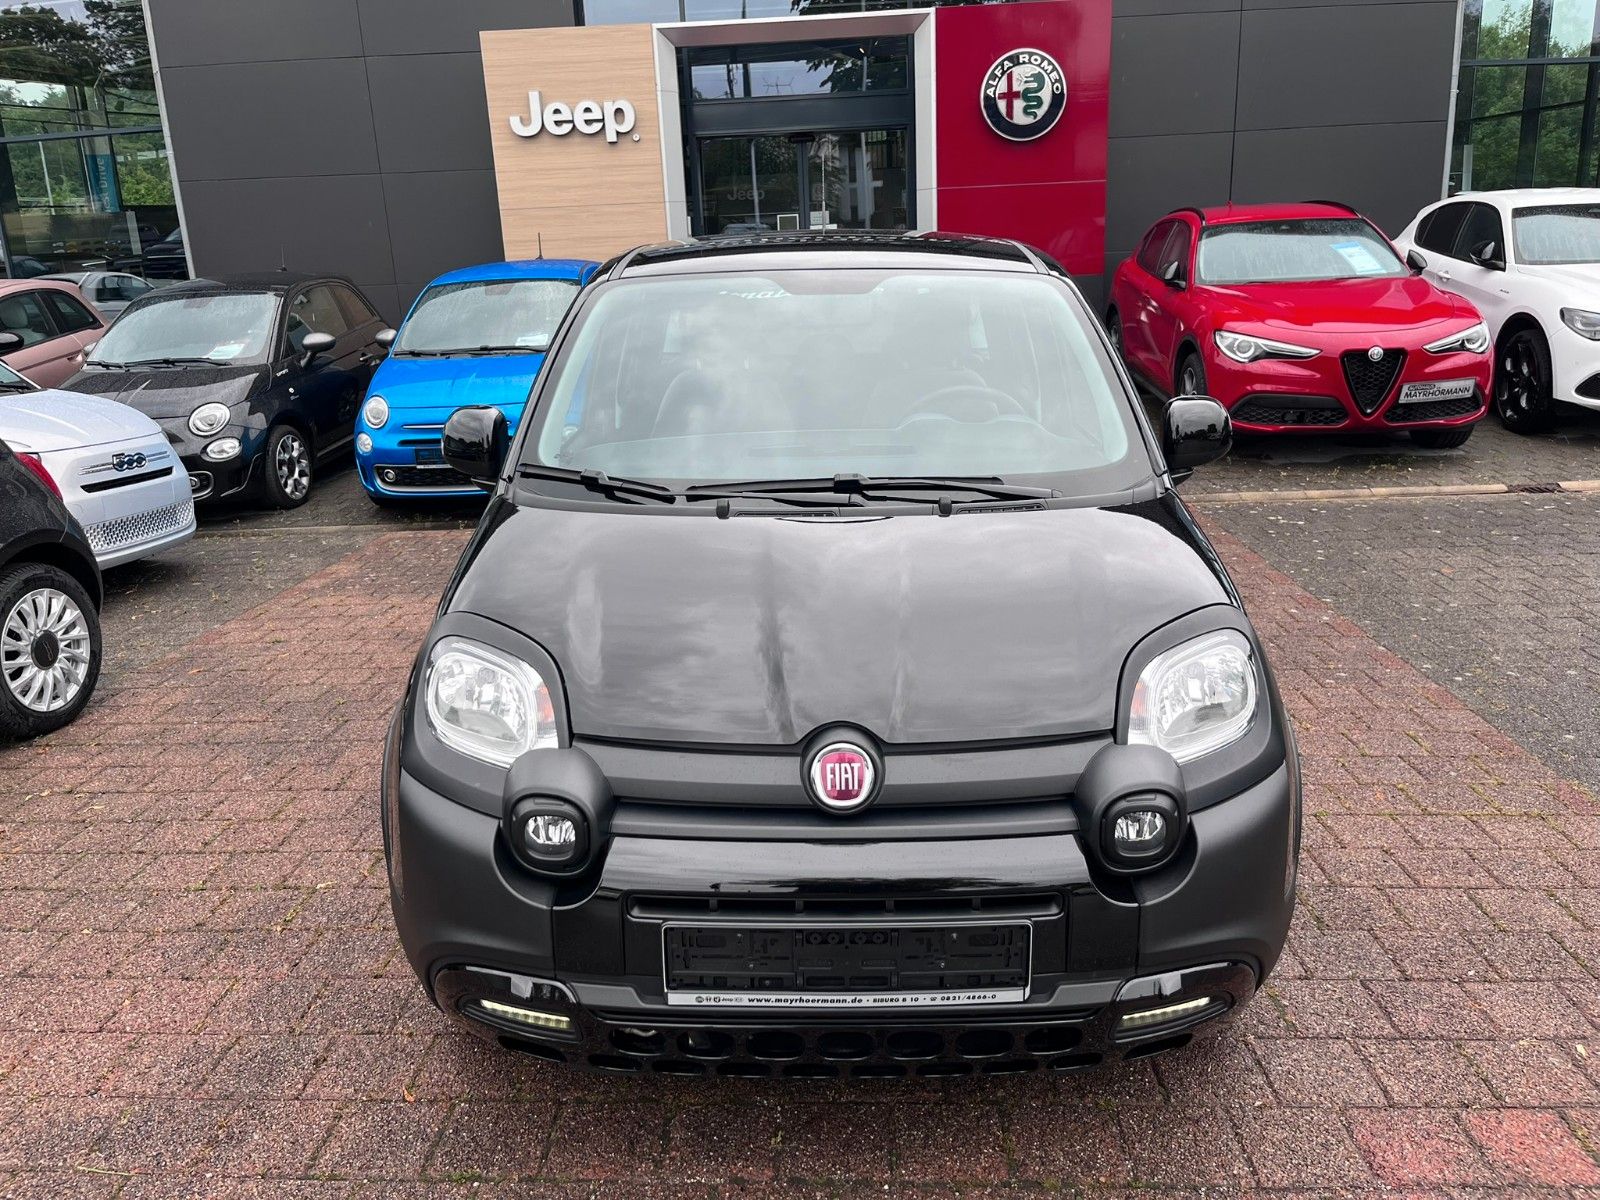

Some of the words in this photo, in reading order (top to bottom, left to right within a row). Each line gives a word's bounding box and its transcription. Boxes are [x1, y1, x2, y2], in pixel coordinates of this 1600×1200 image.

[986, 60, 1013, 98] ALFA
[1019, 54, 1062, 94] ROMEO
[509, 90, 636, 143] Jeep
[97, 158, 108, 188] Drive
[112, 452, 146, 472] 500
[826, 763, 860, 790] FIAT
[748, 996, 863, 1004] www.mayrhoermann.de
